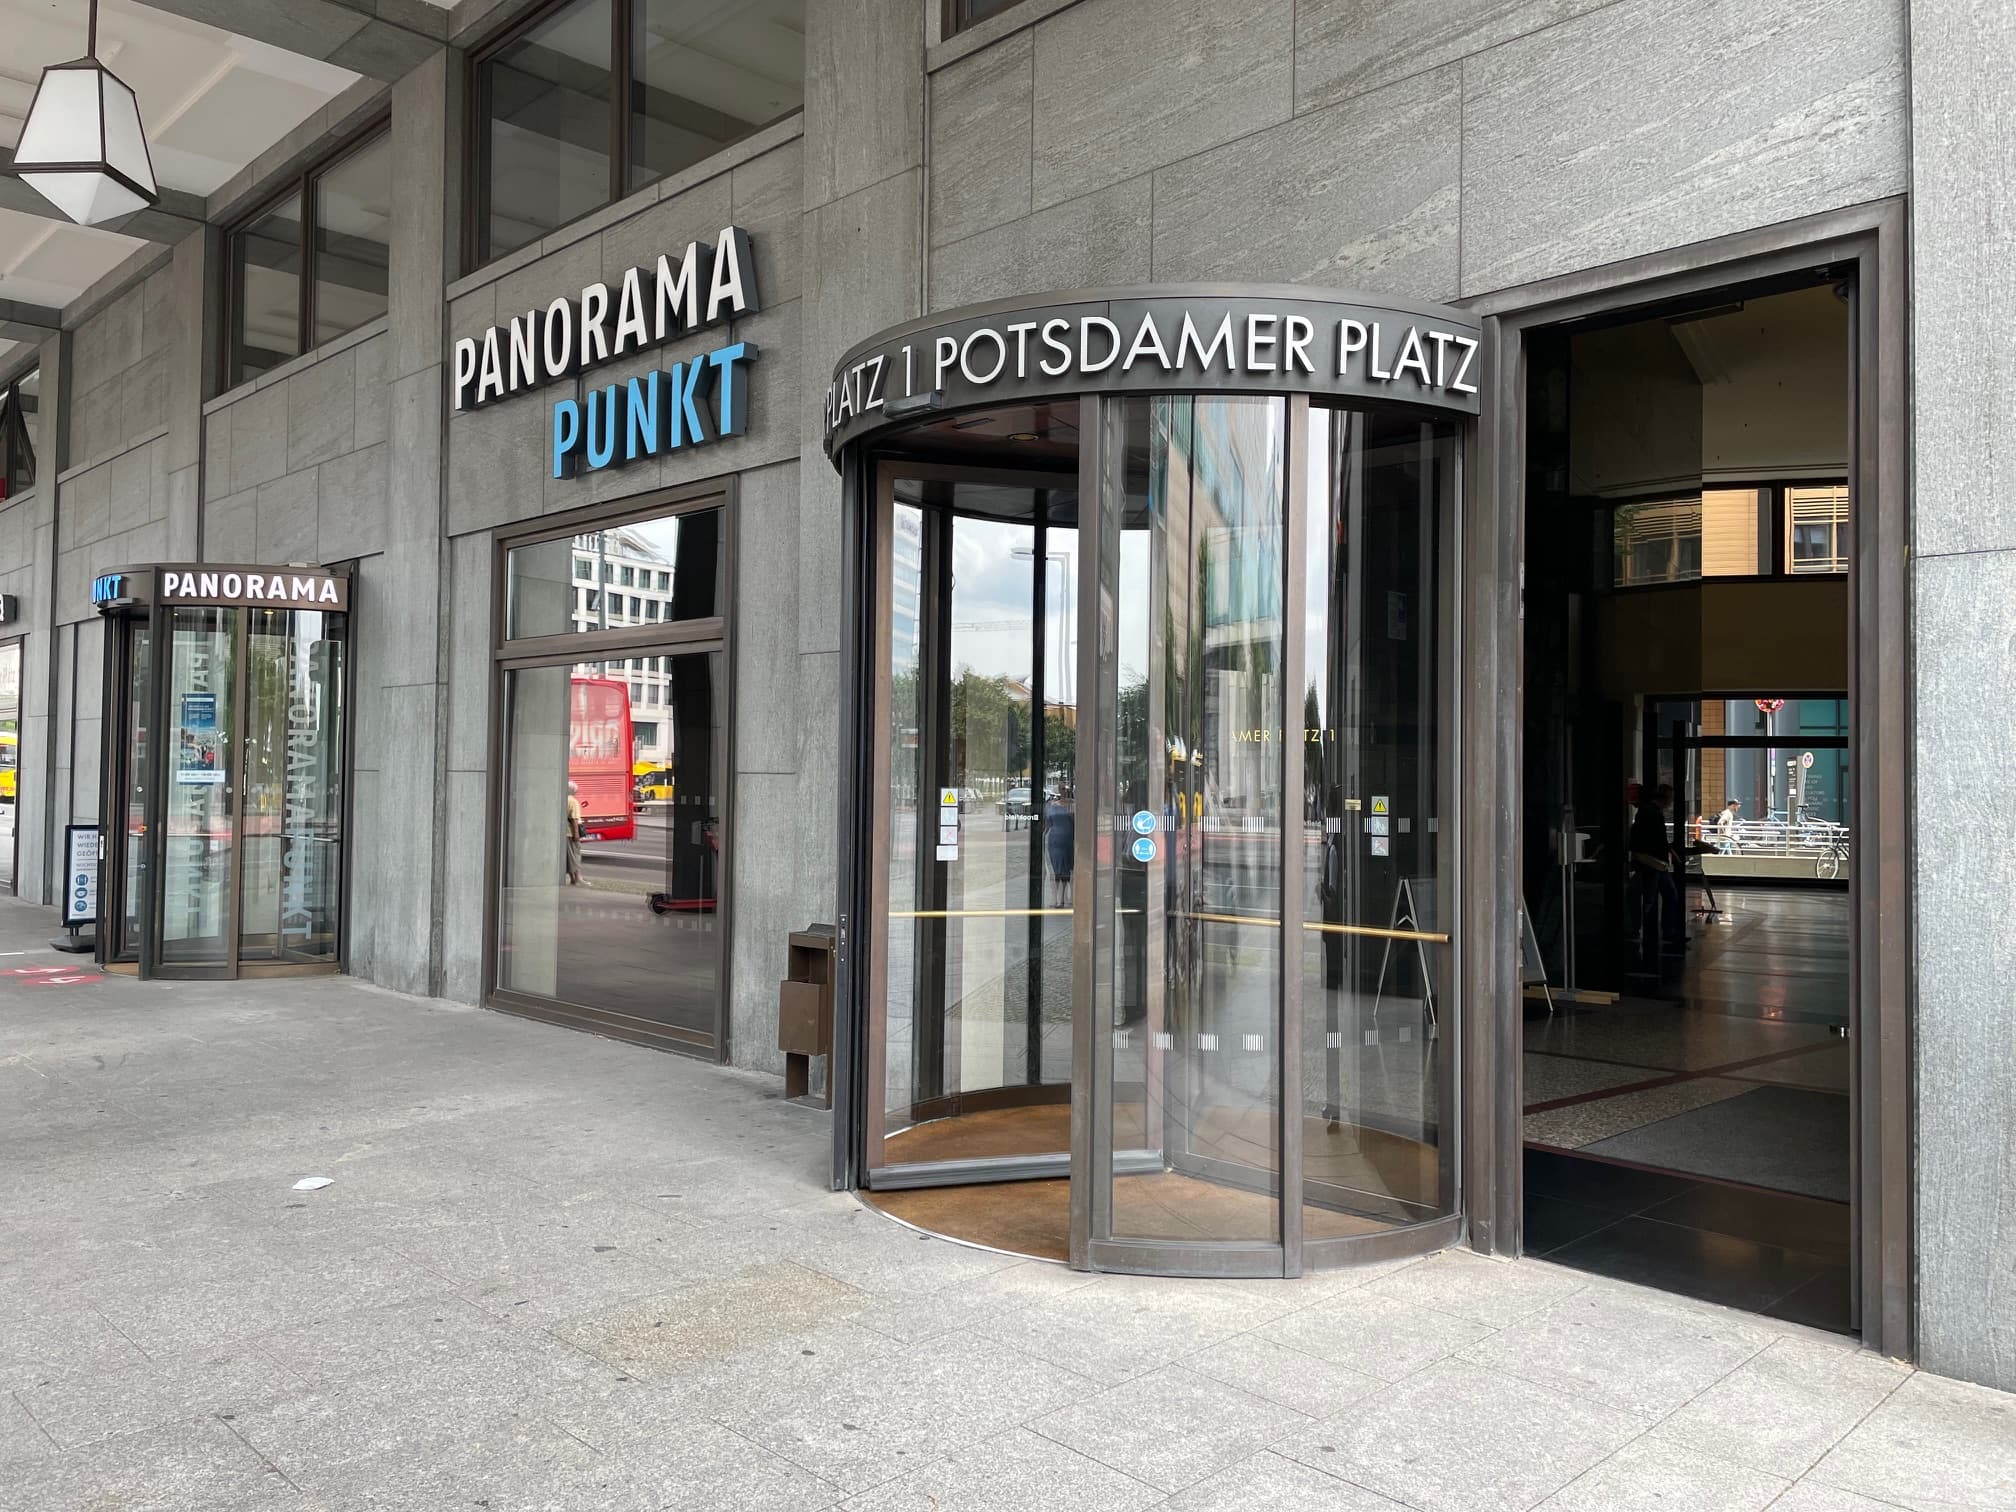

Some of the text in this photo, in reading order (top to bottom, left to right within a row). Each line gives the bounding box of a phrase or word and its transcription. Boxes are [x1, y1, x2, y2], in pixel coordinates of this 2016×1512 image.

[454, 225, 747, 410] PANORAMA
[826, 311, 1479, 433] PLATZ 1 POTSDAMER PLATZ
[554, 342, 746, 479] PUNKT
[164, 572, 340, 603] PANORAMA
